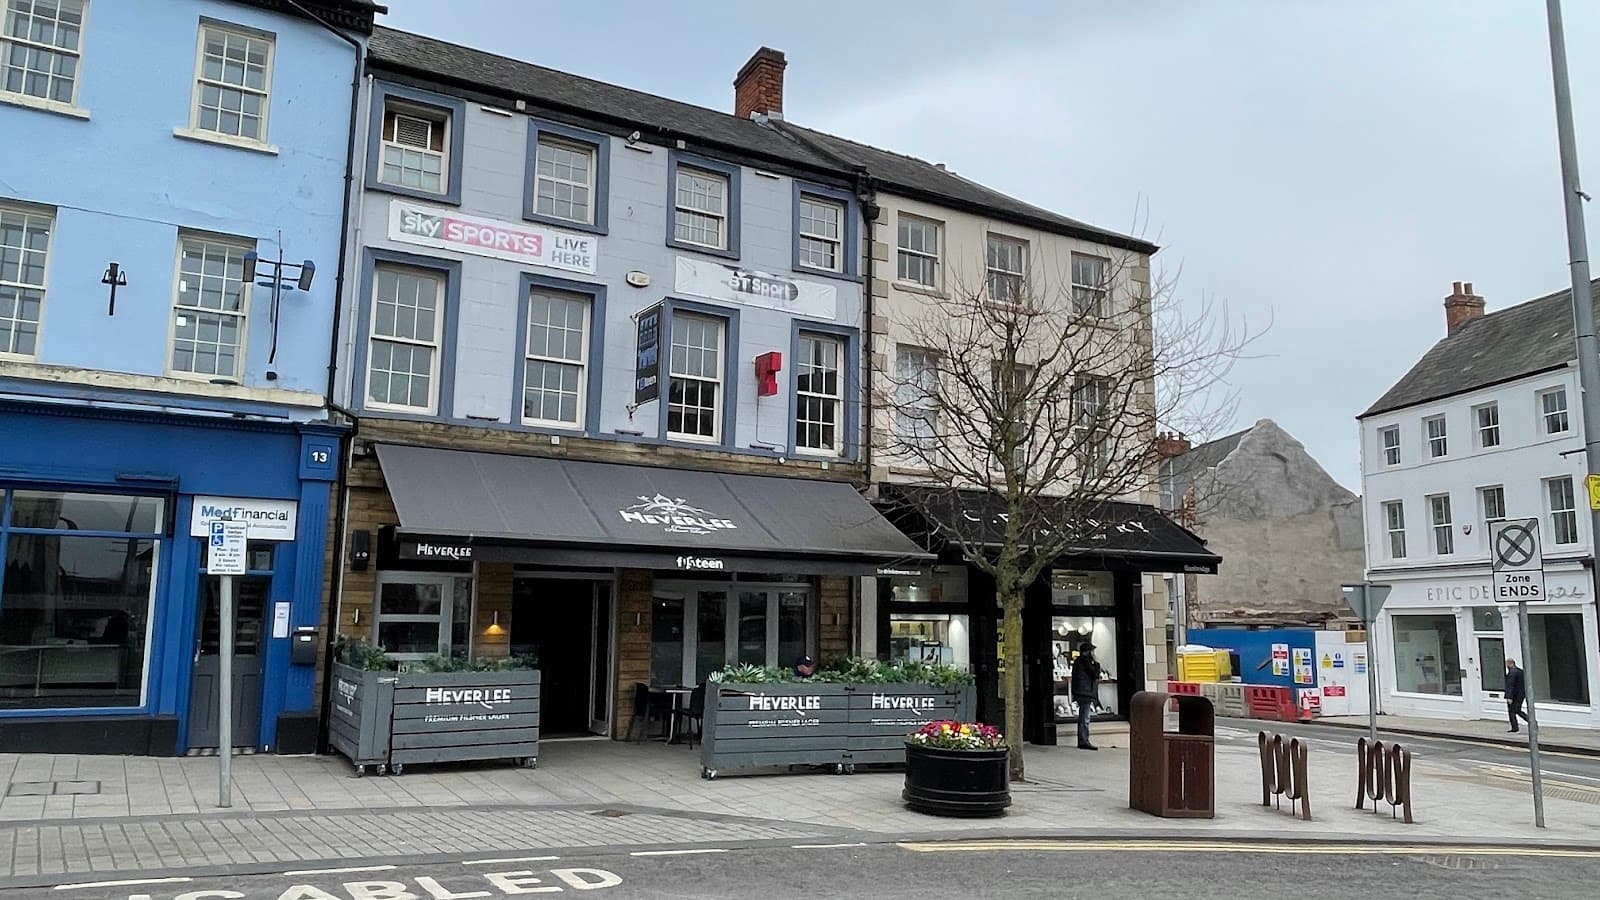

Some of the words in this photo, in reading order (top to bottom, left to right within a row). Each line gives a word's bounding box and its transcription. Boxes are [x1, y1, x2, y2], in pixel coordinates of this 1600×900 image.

[404, 213, 440, 237] sky
[448, 223, 538, 253] SPORTS
[555, 236, 588, 253] LIVE
[552, 250, 591, 268] HERE
[312, 451, 328, 463] 13
[416, 543, 473, 560] HEVERLEE
[1505, 574, 1531, 583] Zone
[1427, 587, 1462, 601] EPIC
[1500, 585, 1540, 597] ENDS
[426, 687, 512, 709] HEVERLEE
[749, 692, 821, 716] HEVERLEE
[872, 692, 935, 716] HEVERLEE
[128, 868, 624, 900] ABLED
